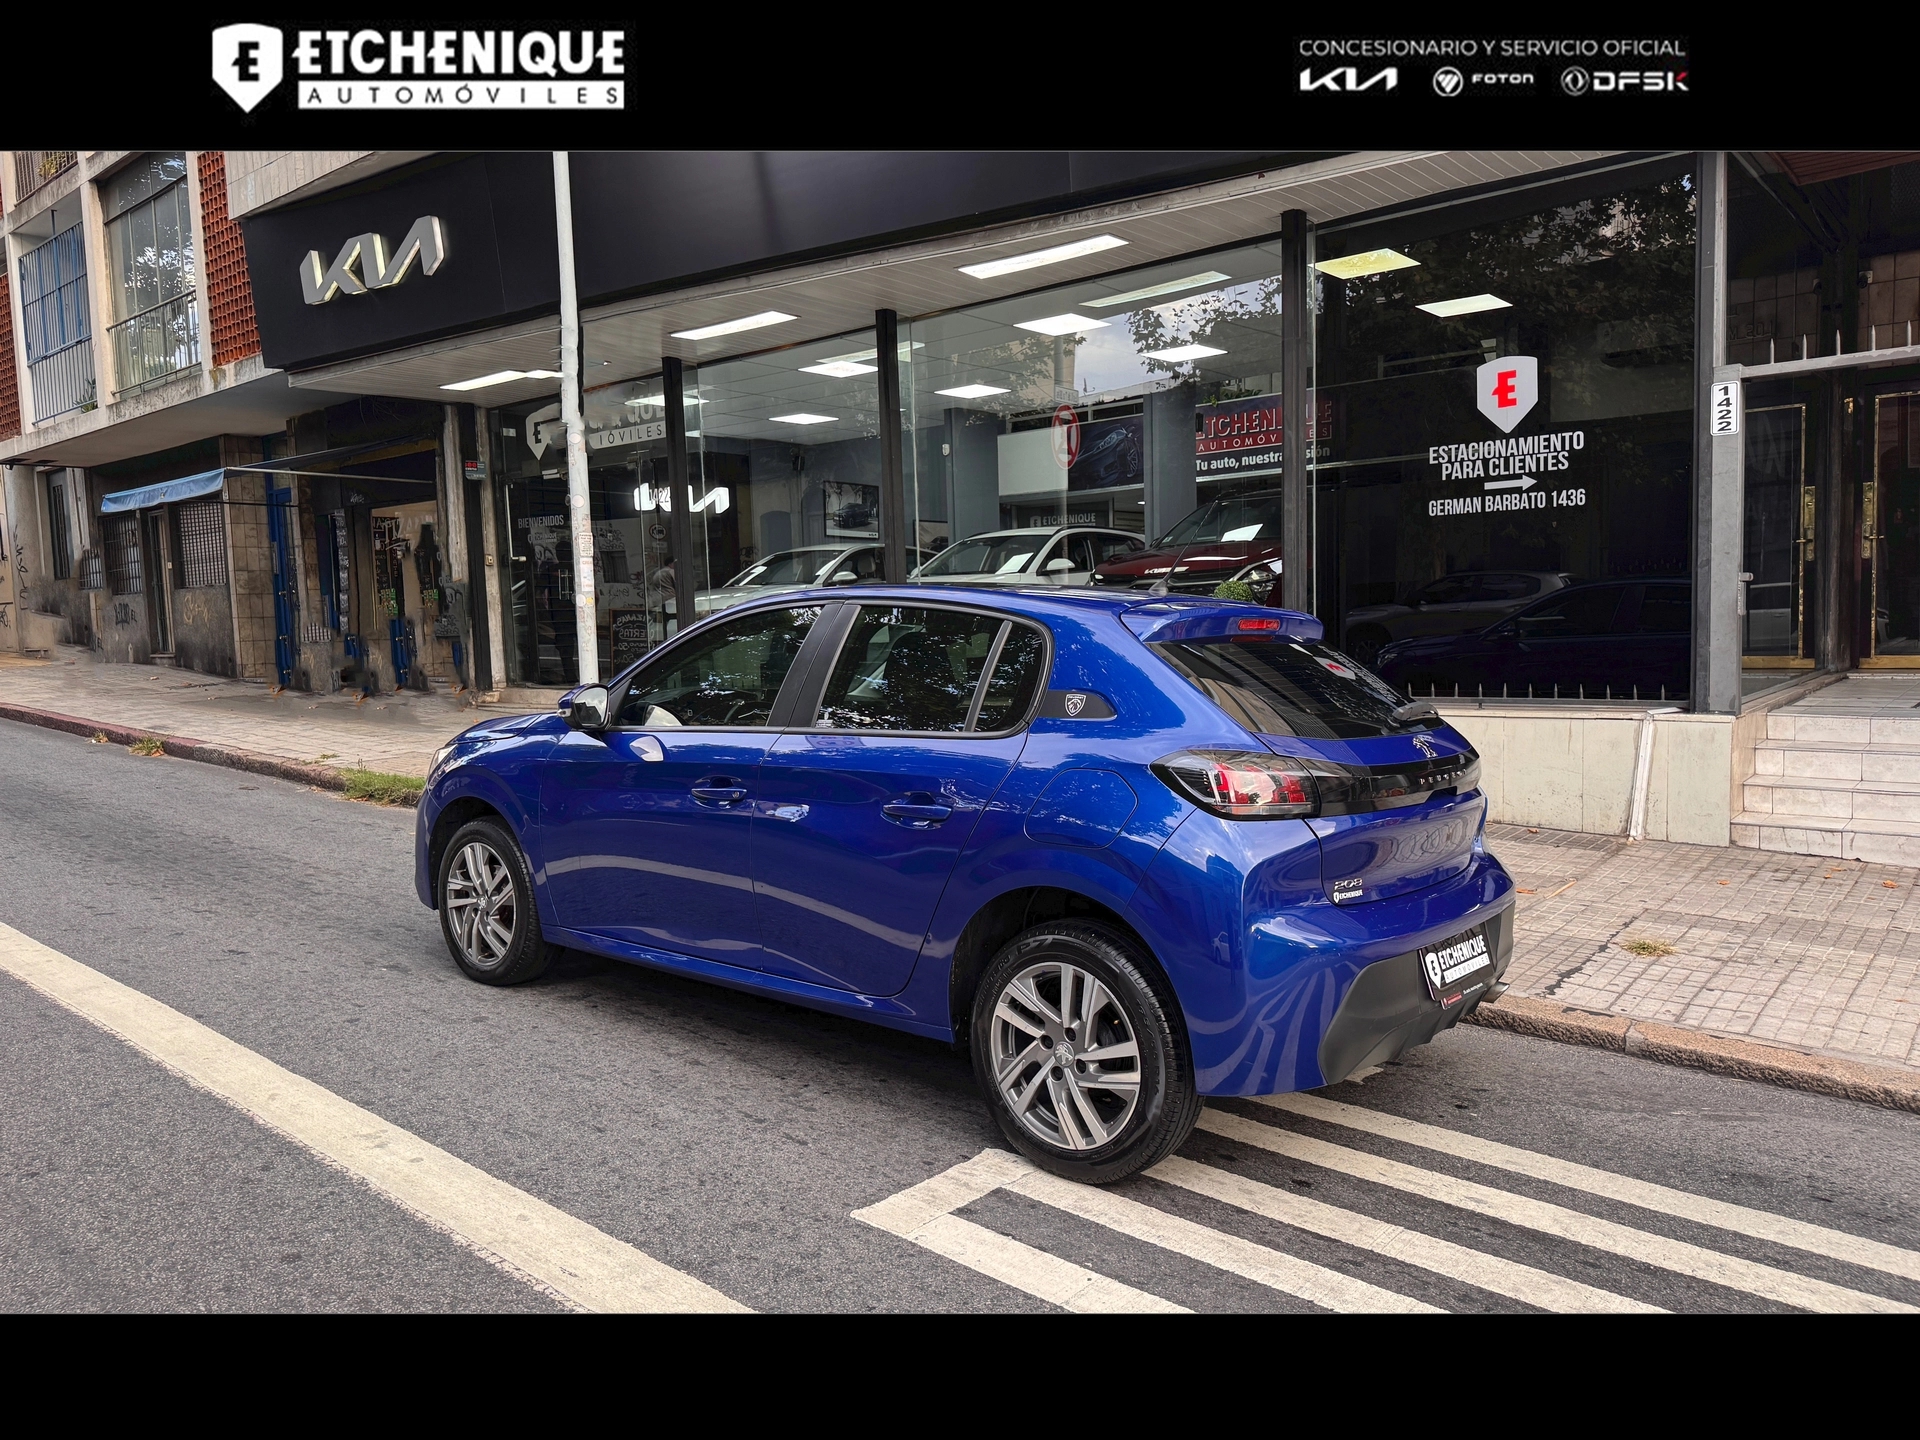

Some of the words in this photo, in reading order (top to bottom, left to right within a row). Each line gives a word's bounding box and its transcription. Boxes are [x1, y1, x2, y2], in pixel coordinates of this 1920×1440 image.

[300, 215, 445, 306] KIA
[1717, 385, 1733, 433] 1422
[1429, 430, 1585, 465] ESTACIONAMIENTO
[1196, 460, 1208, 471] Tu
[1210, 457, 1240, 469] auto,
[1441, 458, 1485, 481] PARA
[1488, 451, 1570, 477] CLIENTES
[1428, 496, 1482, 517] GERMAN
[1484, 491, 1546, 512] BARBATO
[1551, 488, 1586, 508] 1436
[518, 514, 565, 529] BIENVENIDOS
[1042, 512, 1096, 526] ETCHENIQUE
[1334, 877, 1363, 890] 208
[1437, 934, 1487, 970] ETCHENIQUE
